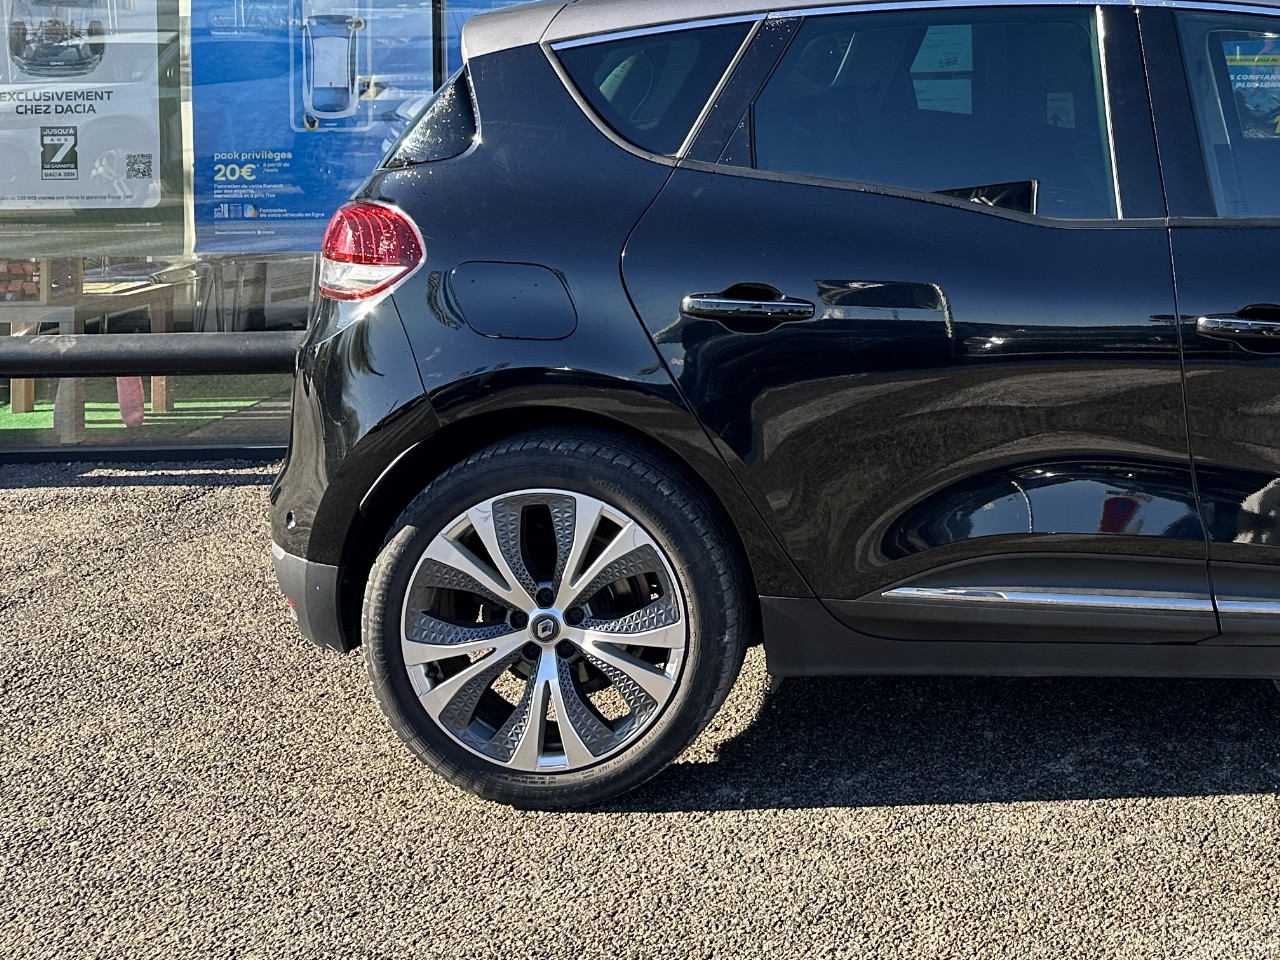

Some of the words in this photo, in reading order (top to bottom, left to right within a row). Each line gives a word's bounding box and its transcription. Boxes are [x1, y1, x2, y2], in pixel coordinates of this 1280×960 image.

[0, 90, 114, 102] EXCLUSIVEMENT
[15, 104, 51, 115] CHEZ
[54, 103, 97, 115] DACIA
[43, 127, 75, 135] JUSQU'À
[43, 135, 75, 163] 7
[213, 151, 240, 161] pack
[241, 151, 293, 162] privilèges
[213, 164, 257, 181] 20€
